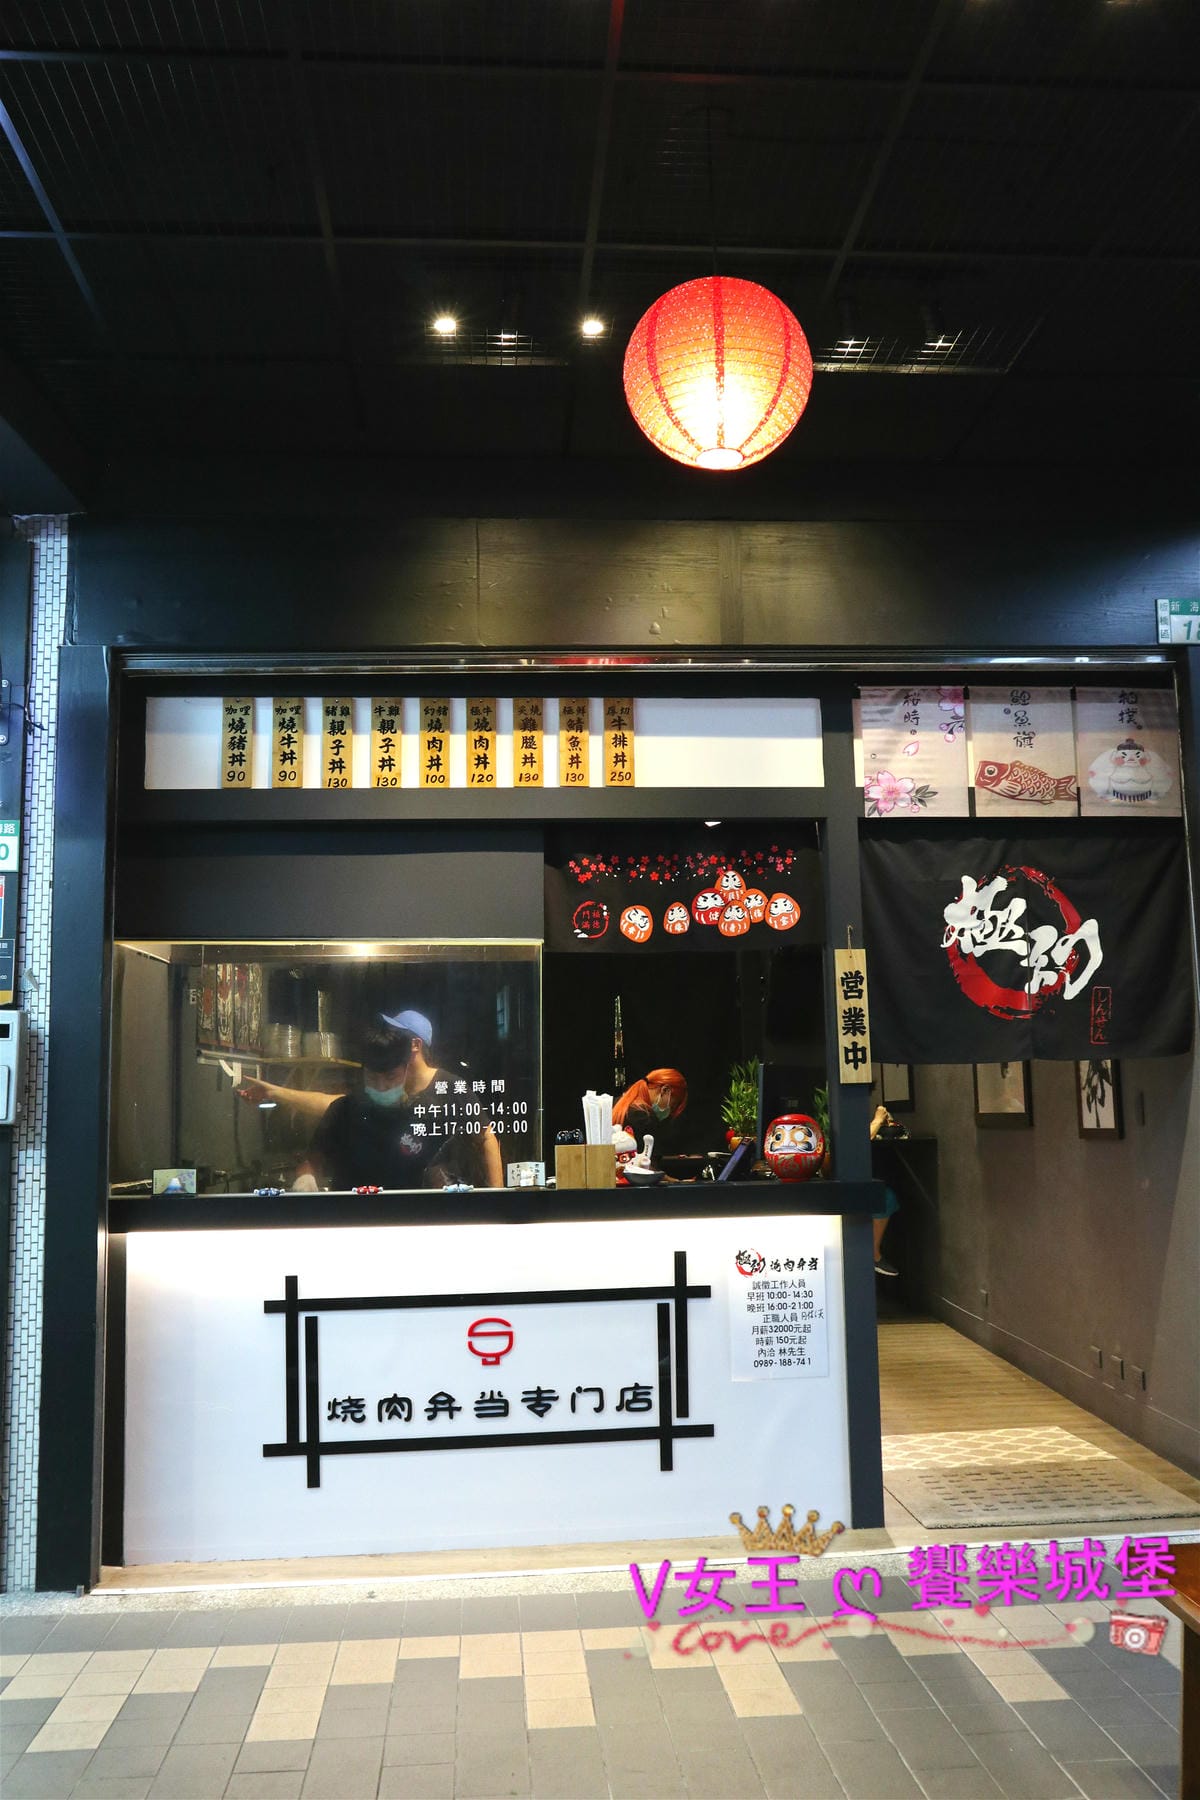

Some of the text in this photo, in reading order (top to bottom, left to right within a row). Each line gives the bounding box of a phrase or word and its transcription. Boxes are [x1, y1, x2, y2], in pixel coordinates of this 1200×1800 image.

[225, 705, 251, 716] 咖哩
[275, 705, 302, 716] 咖哩
[278, 716, 298, 766] 燒牛丼
[327, 719, 347, 775] 親子丼
[377, 719, 397, 773] 親子丼
[426, 717, 445, 772] 燒肉丼
[472, 717, 492, 770] 燒肉丼
[520, 717, 538, 768] 雞腿丼
[566, 717, 584, 769] 鯖魚丼
[610, 716, 629, 768] 牛排丼
[226, 770, 246, 782] 90
[278, 770, 297, 782] 90
[376, 777, 398, 787] 130
[425, 774, 446, 784] 100
[471, 773, 494, 783] 120
[519, 773, 539, 782] 130
[566, 772, 585, 782] 130
[610, 771, 632, 782] 250
[327, 778, 348, 788] 130
[840, 970, 868, 1070] 営業中
[434, 1079, 506, 1095] 營業時間
[413, 1101, 528, 1119] 中午11:00-14:00
[747, 1292, 765, 1302] 早班
[747, 1304, 765, 1313] 晚班
[779, 1346, 806, 1357] 林先生
[753, 1357, 811, 1369] 0989-188-741
